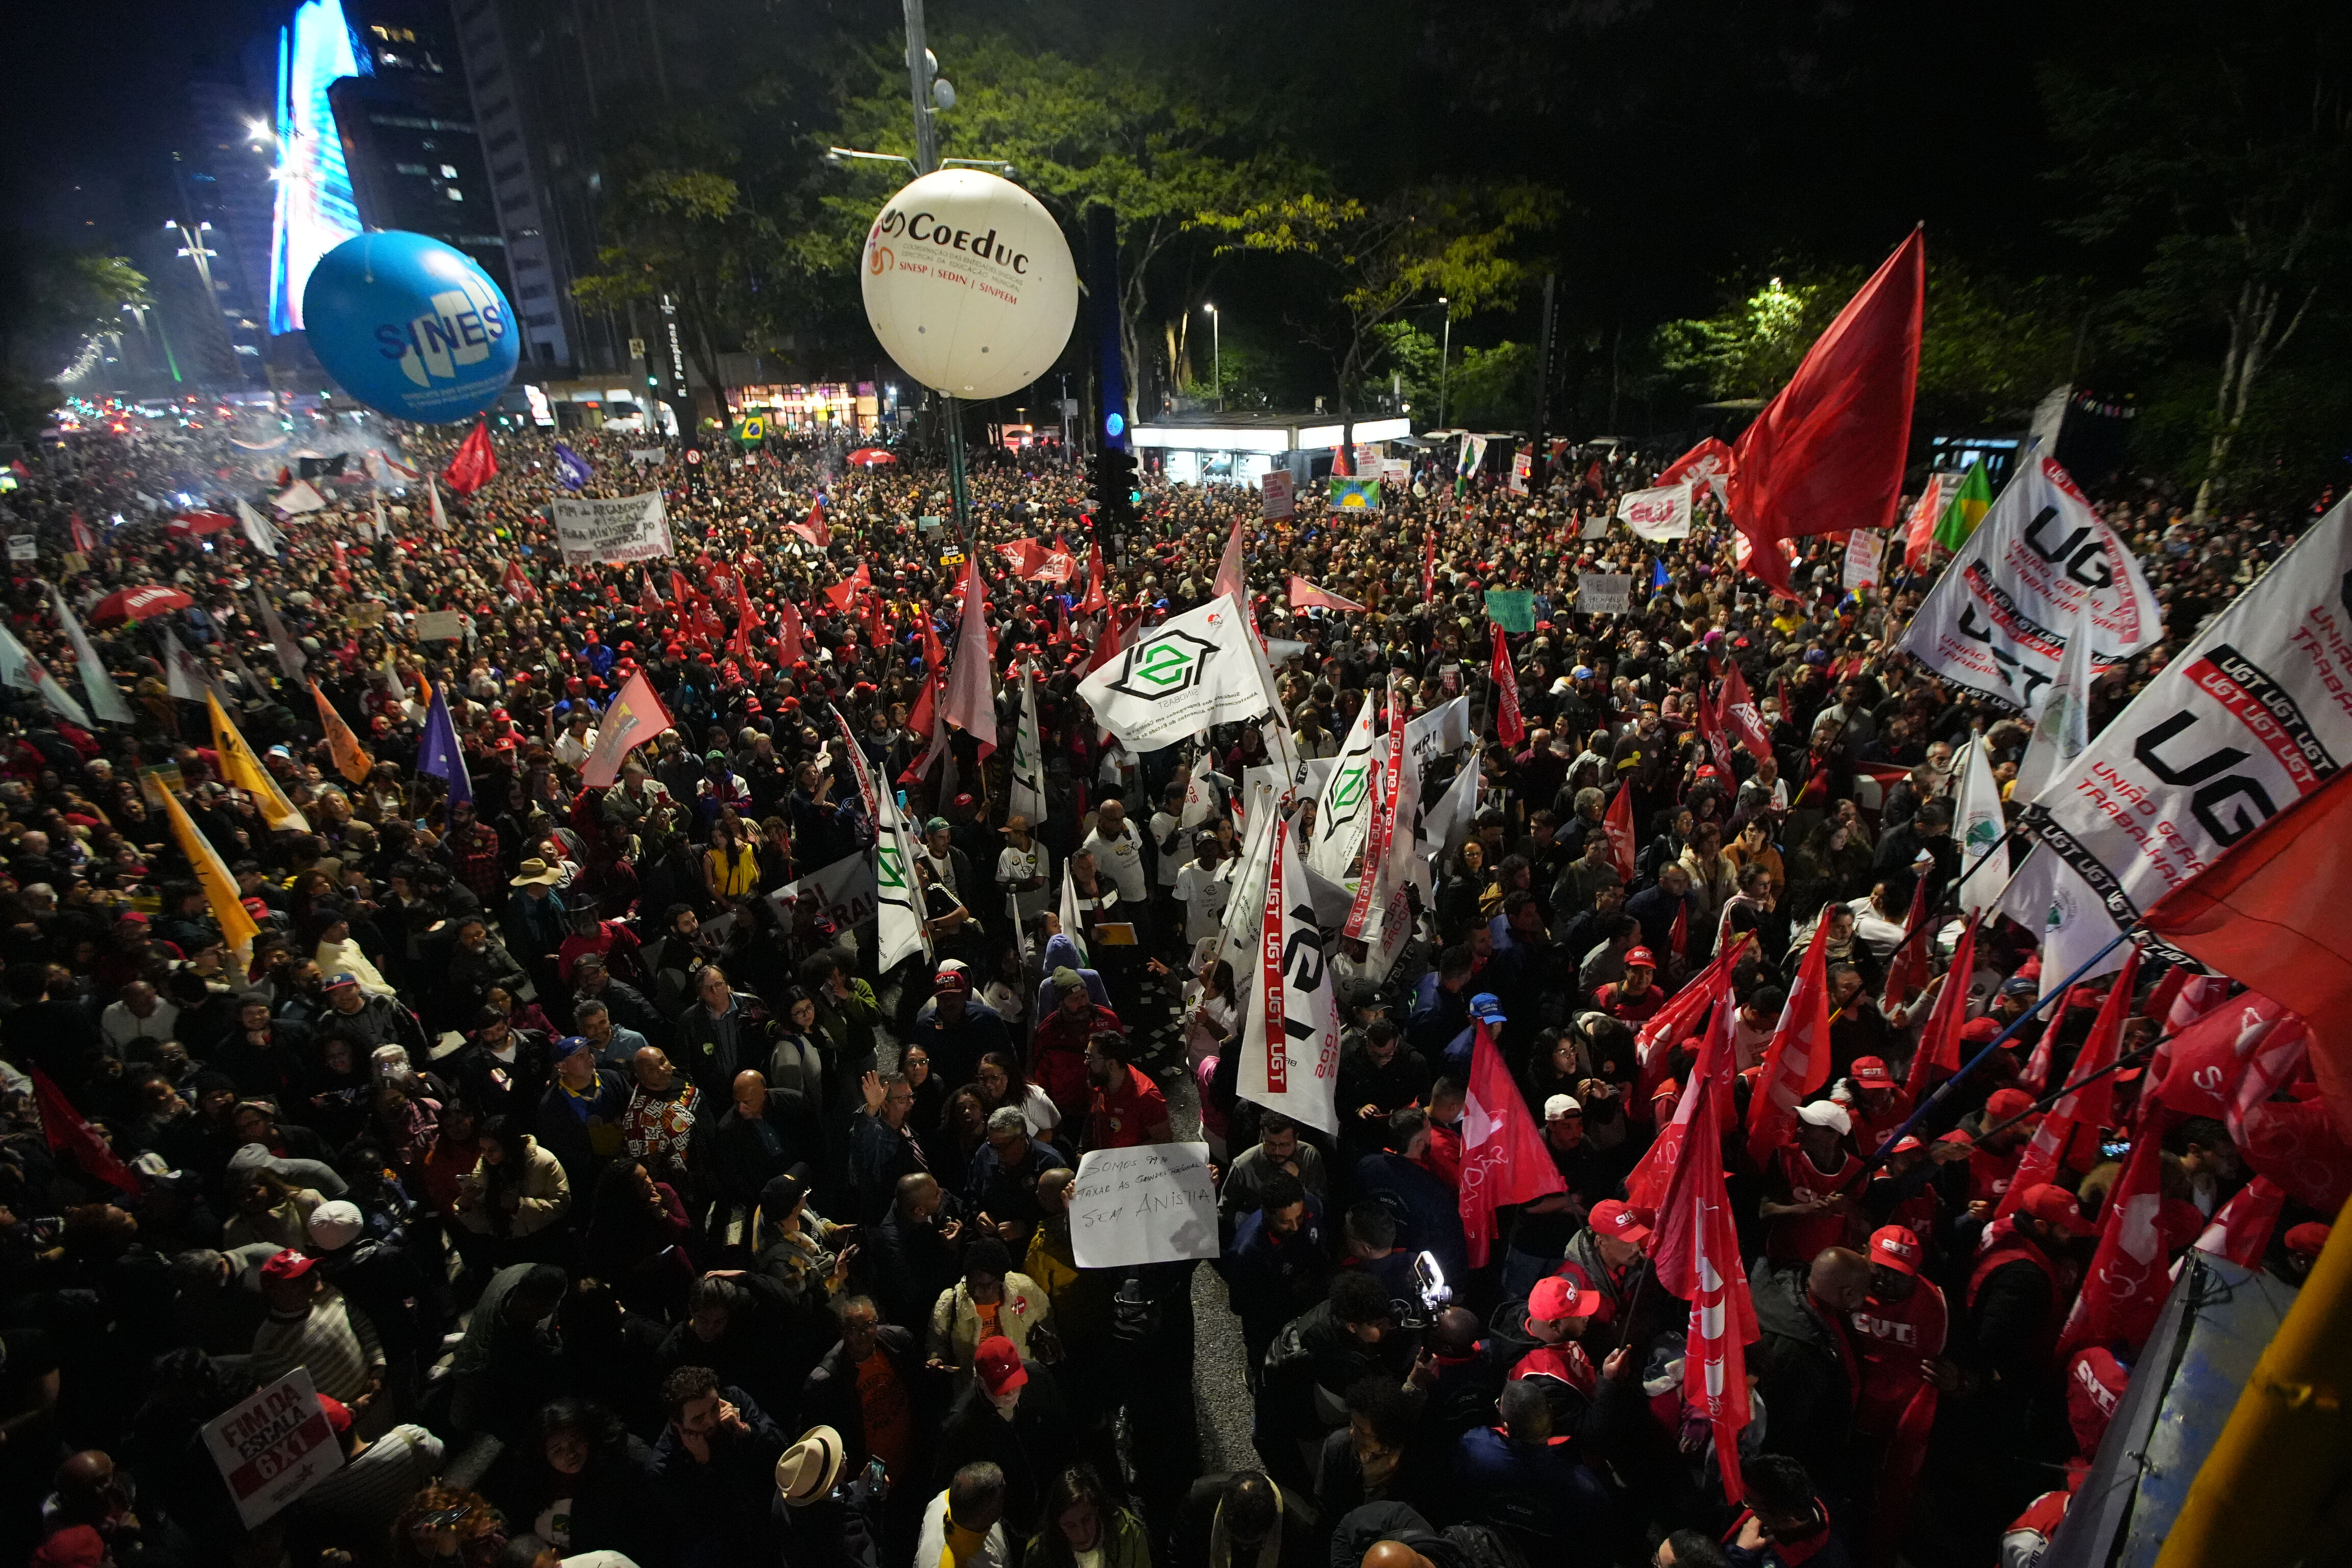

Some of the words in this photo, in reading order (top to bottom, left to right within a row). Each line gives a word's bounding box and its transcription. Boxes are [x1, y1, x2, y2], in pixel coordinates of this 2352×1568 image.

[899, 261, 928, 274] SINESP
[938, 269, 968, 285] SEDIN
[979, 282, 1017, 305] SINPEEM
[949, 261, 988, 278] EDUCAÇÃO
[2024, 504, 2113, 589] UG
[1034, 564, 1065, 575] ABC
[1940, 633, 1988, 662] UNIÃO
[2201, 672, 2248, 708] UGT
[2244, 705, 2289, 743] UGT
[2278, 745, 2316, 783] UGT
[2219, 656, 2267, 696] UGT
[2260, 690, 2301, 728] UGT
[2296, 730, 2336, 771] UGT
[2134, 708, 2280, 849] UG
[2093, 761, 2159, 816] UNIÃO
[2157, 820, 2208, 874] GERA
[2041, 824, 2084, 857] UGT
[2076, 860, 2117, 891] UGT
[2106, 890, 2140, 922] UGT
[2158, 950, 2197, 966] UGT
[1266, 933, 1281, 974] UGT
[936, 975, 955, 985] HÉLIO
[1268, 987, 1282, 1027] UGT
[1270, 1043, 1285, 1085] UGT
[1862, 1067, 1883, 1076] CUT
[1080, 1156, 1137, 1180] SOMOS
[1075, 1184, 1110, 1200] TAXAR
[1118, 1181, 1130, 1190] AS
[1082, 1207, 1123, 1228] SEM
[1881, 1238, 1912, 1255] CUT
[1851, 1312, 1913, 1342] CUT
[2076, 1359, 2117, 1411] CUT
[220, 1403, 271, 1449] FIM
[264, 1383, 303, 1418] DA
